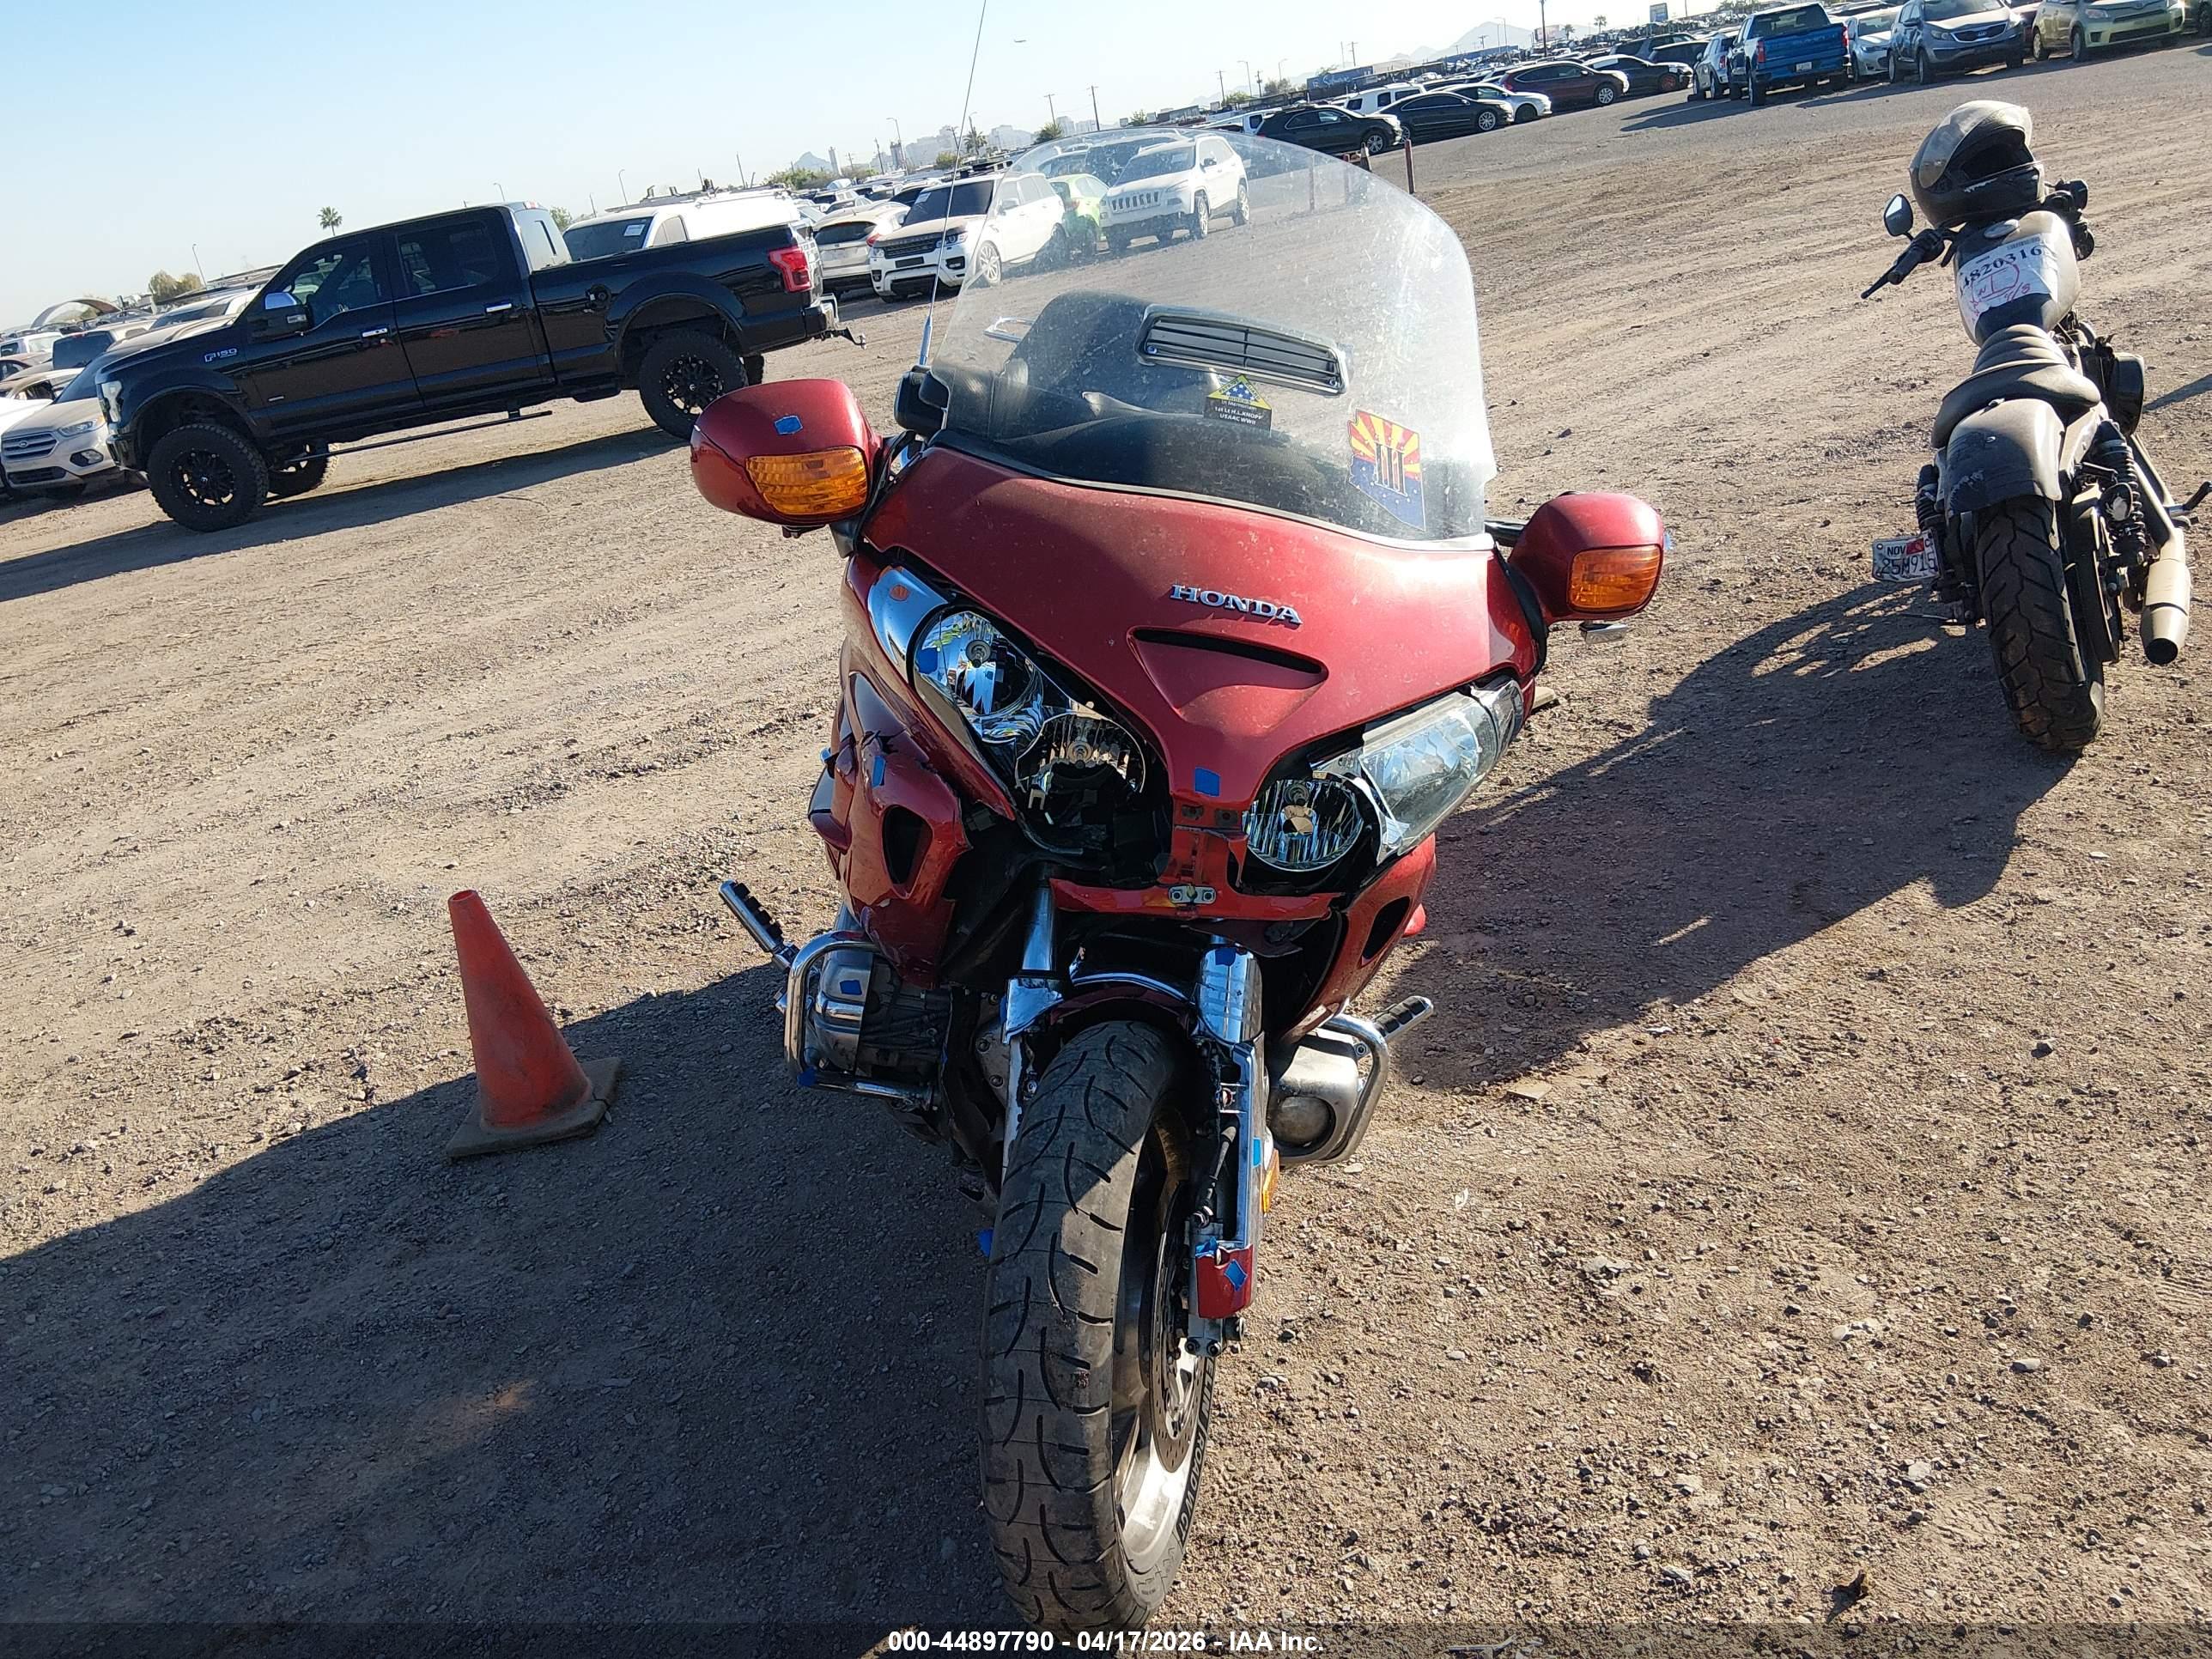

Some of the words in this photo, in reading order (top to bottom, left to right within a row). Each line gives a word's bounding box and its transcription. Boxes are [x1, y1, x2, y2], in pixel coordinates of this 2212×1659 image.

[1219, 413, 1240, 422] USAAC
[1887, 545, 1905, 556] NOV
[1170, 584, 1303, 625] HONDA
[1190, 1431, 1205, 1492] ROAD
[1179, 1512, 1189, 1541] GT
